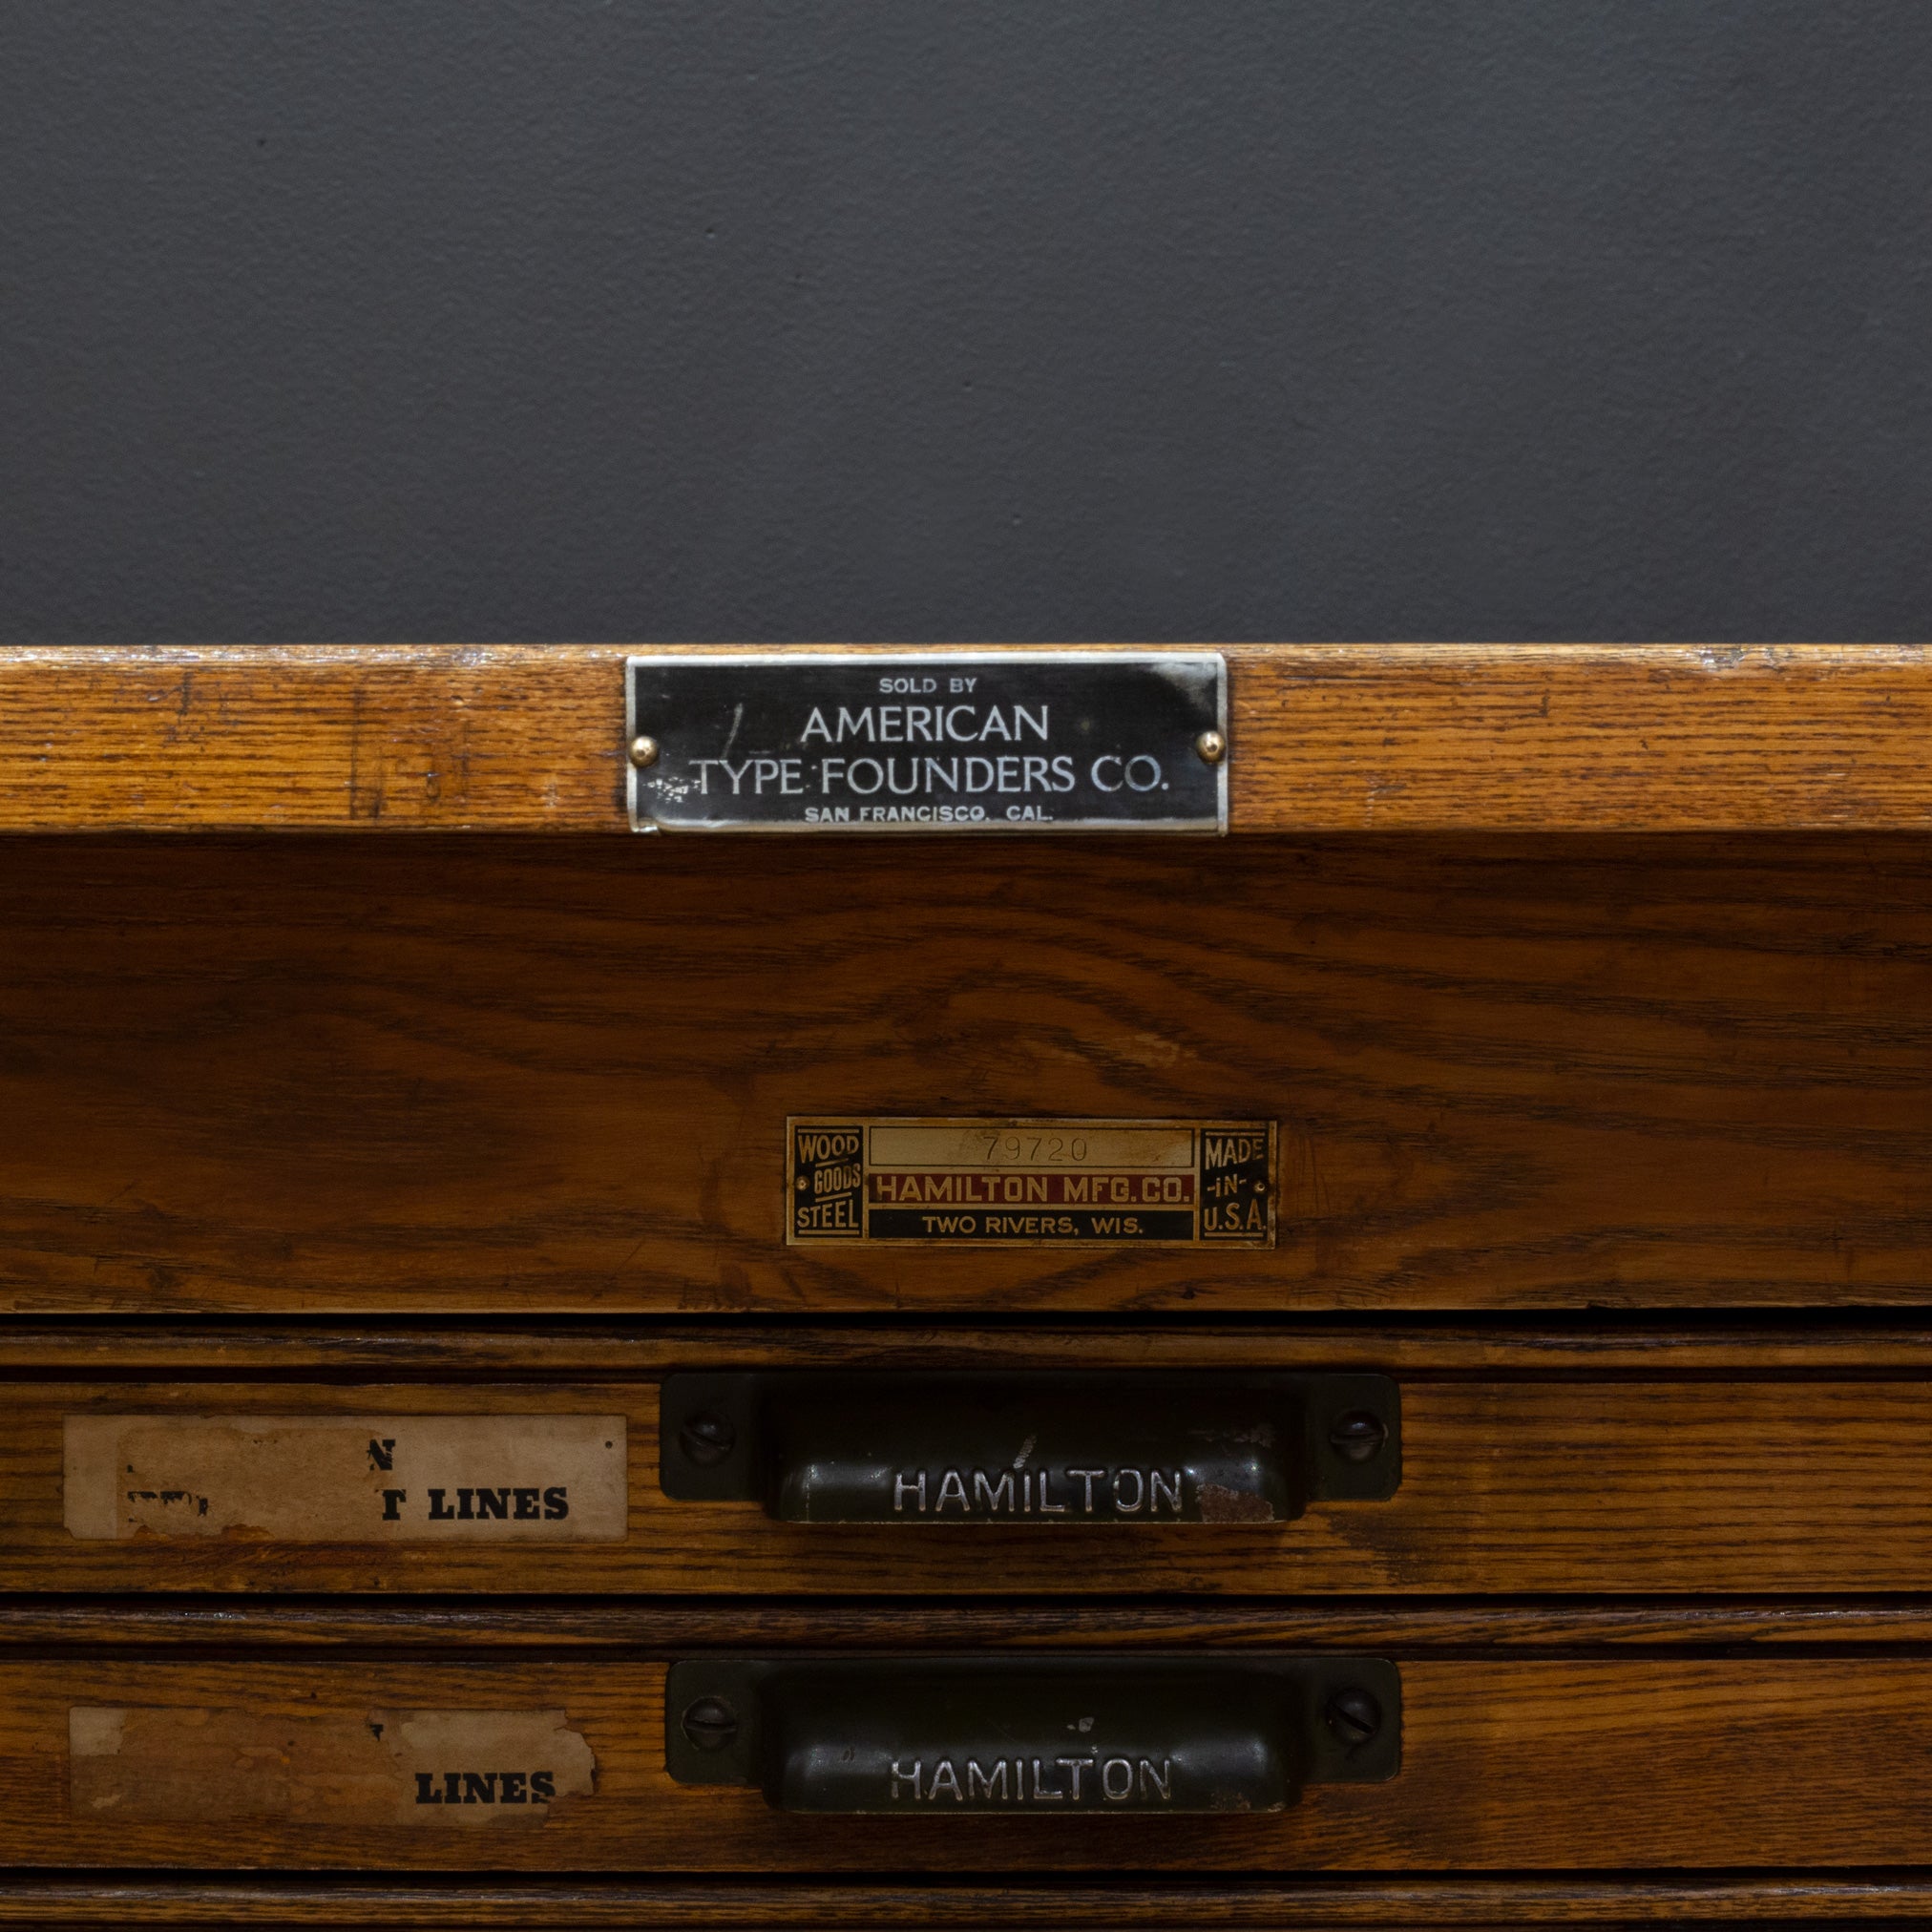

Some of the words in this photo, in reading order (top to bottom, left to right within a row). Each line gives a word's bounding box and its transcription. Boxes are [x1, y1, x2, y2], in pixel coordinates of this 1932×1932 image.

[879, 678, 937, 693] SOLD
[949, 678, 977, 693] BY
[800, 705, 1049, 743] AMERICAN
[689, 759, 804, 795] TYPE
[821, 756, 1076, 794] FOUNDERS
[1090, 756, 1170, 793] CO.
[805, 807, 850, 823] SAN
[797, 1134, 860, 1163] WOOD
[982, 1135, 1088, 1162] 79720
[1205, 1137, 1264, 1170] MADE
[813, 1164, 861, 1194] GOODS
[876, 1175, 1048, 1203] HAMILTON
[797, 1202, 859, 1228] STEEL
[922, 1216, 976, 1233] TWO
[985, 1216, 1079, 1236] RIVERS,
[1091, 1217, 1144, 1233] WIS.
[428, 1487, 569, 1521] LINES
[893, 1469, 1183, 1512] HAMILTON
[414, 1772, 556, 1804] LINES
[891, 1757, 1171, 1800] HAMILTON
